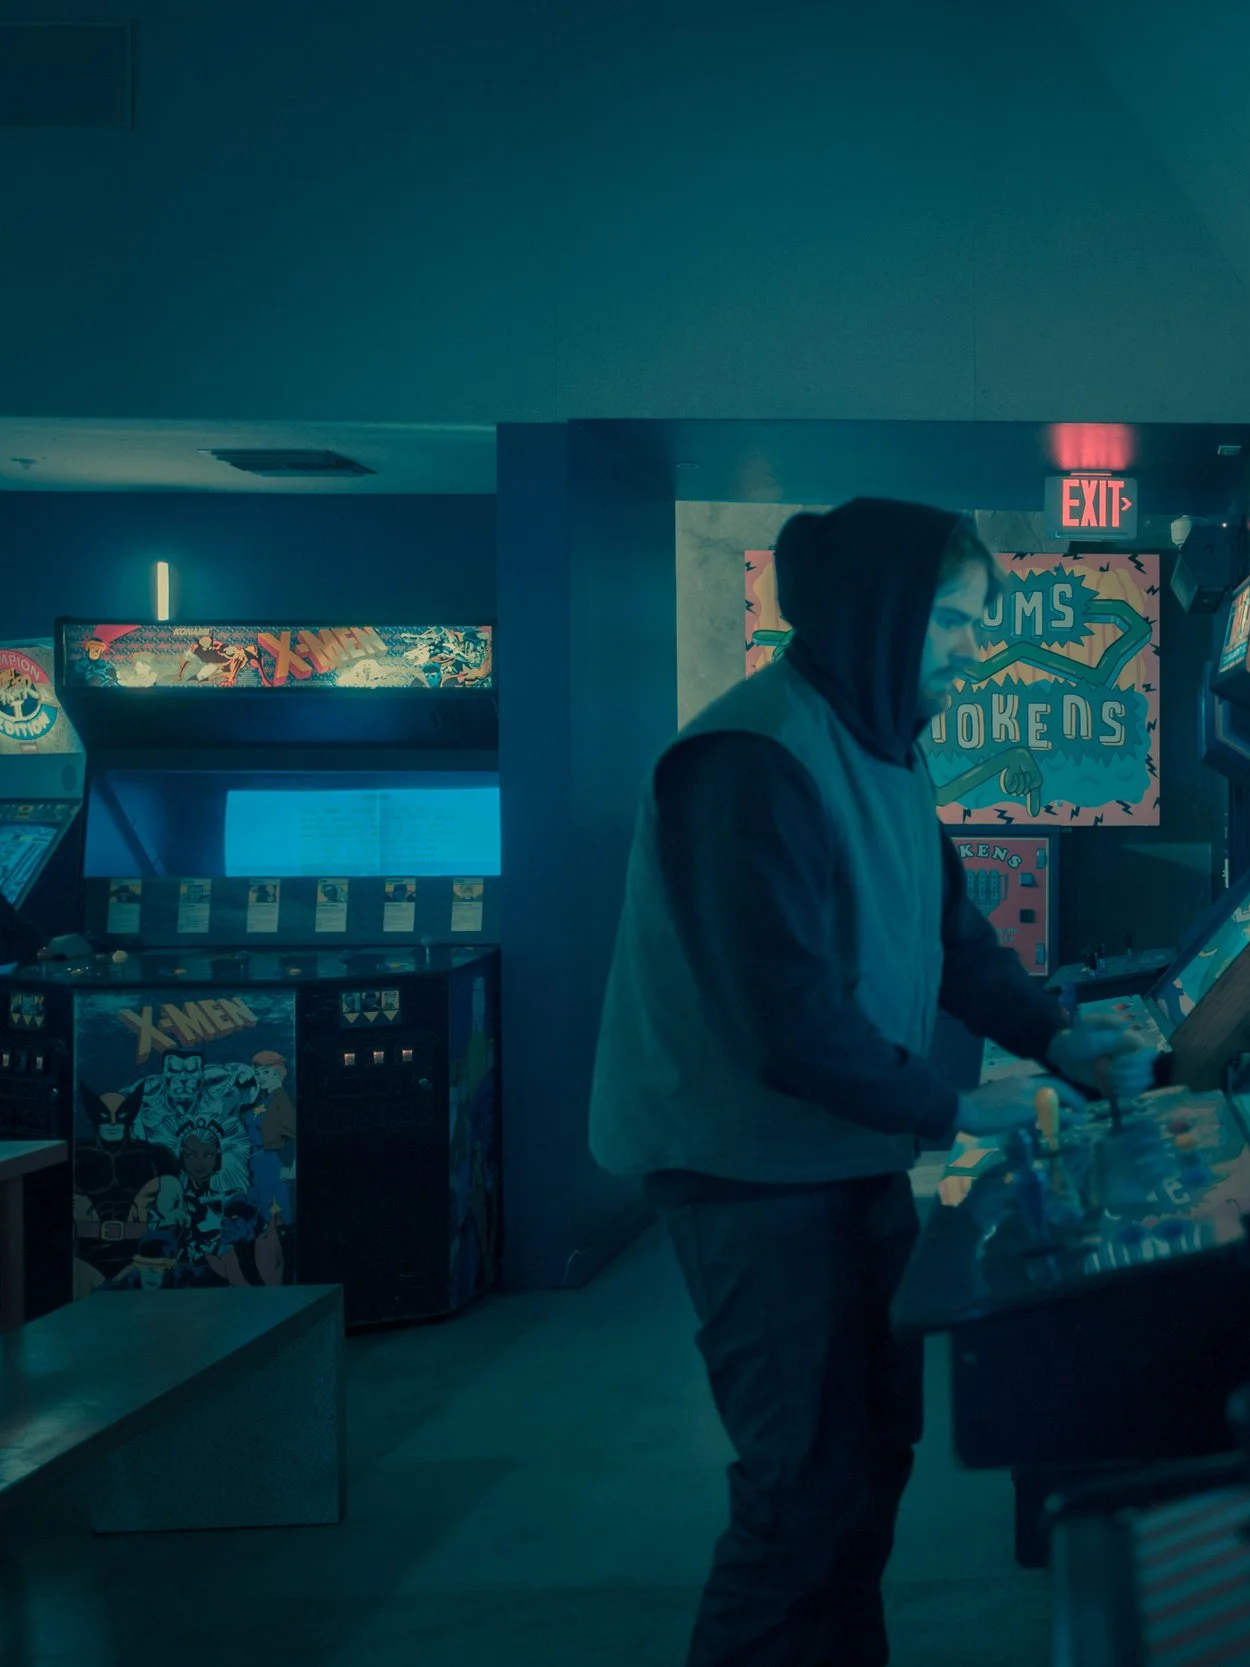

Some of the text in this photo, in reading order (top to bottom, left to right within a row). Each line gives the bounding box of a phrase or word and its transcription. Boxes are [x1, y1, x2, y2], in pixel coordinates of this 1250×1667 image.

[1062, 479, 1125, 528] EXIT
[0, 654, 40, 681] MPION
[257, 626, 388, 687] X-MEN
[0, 712, 51, 737] DITION
[958, 844, 1022, 869] KENS
[117, 996, 259, 1066] X-MEN
